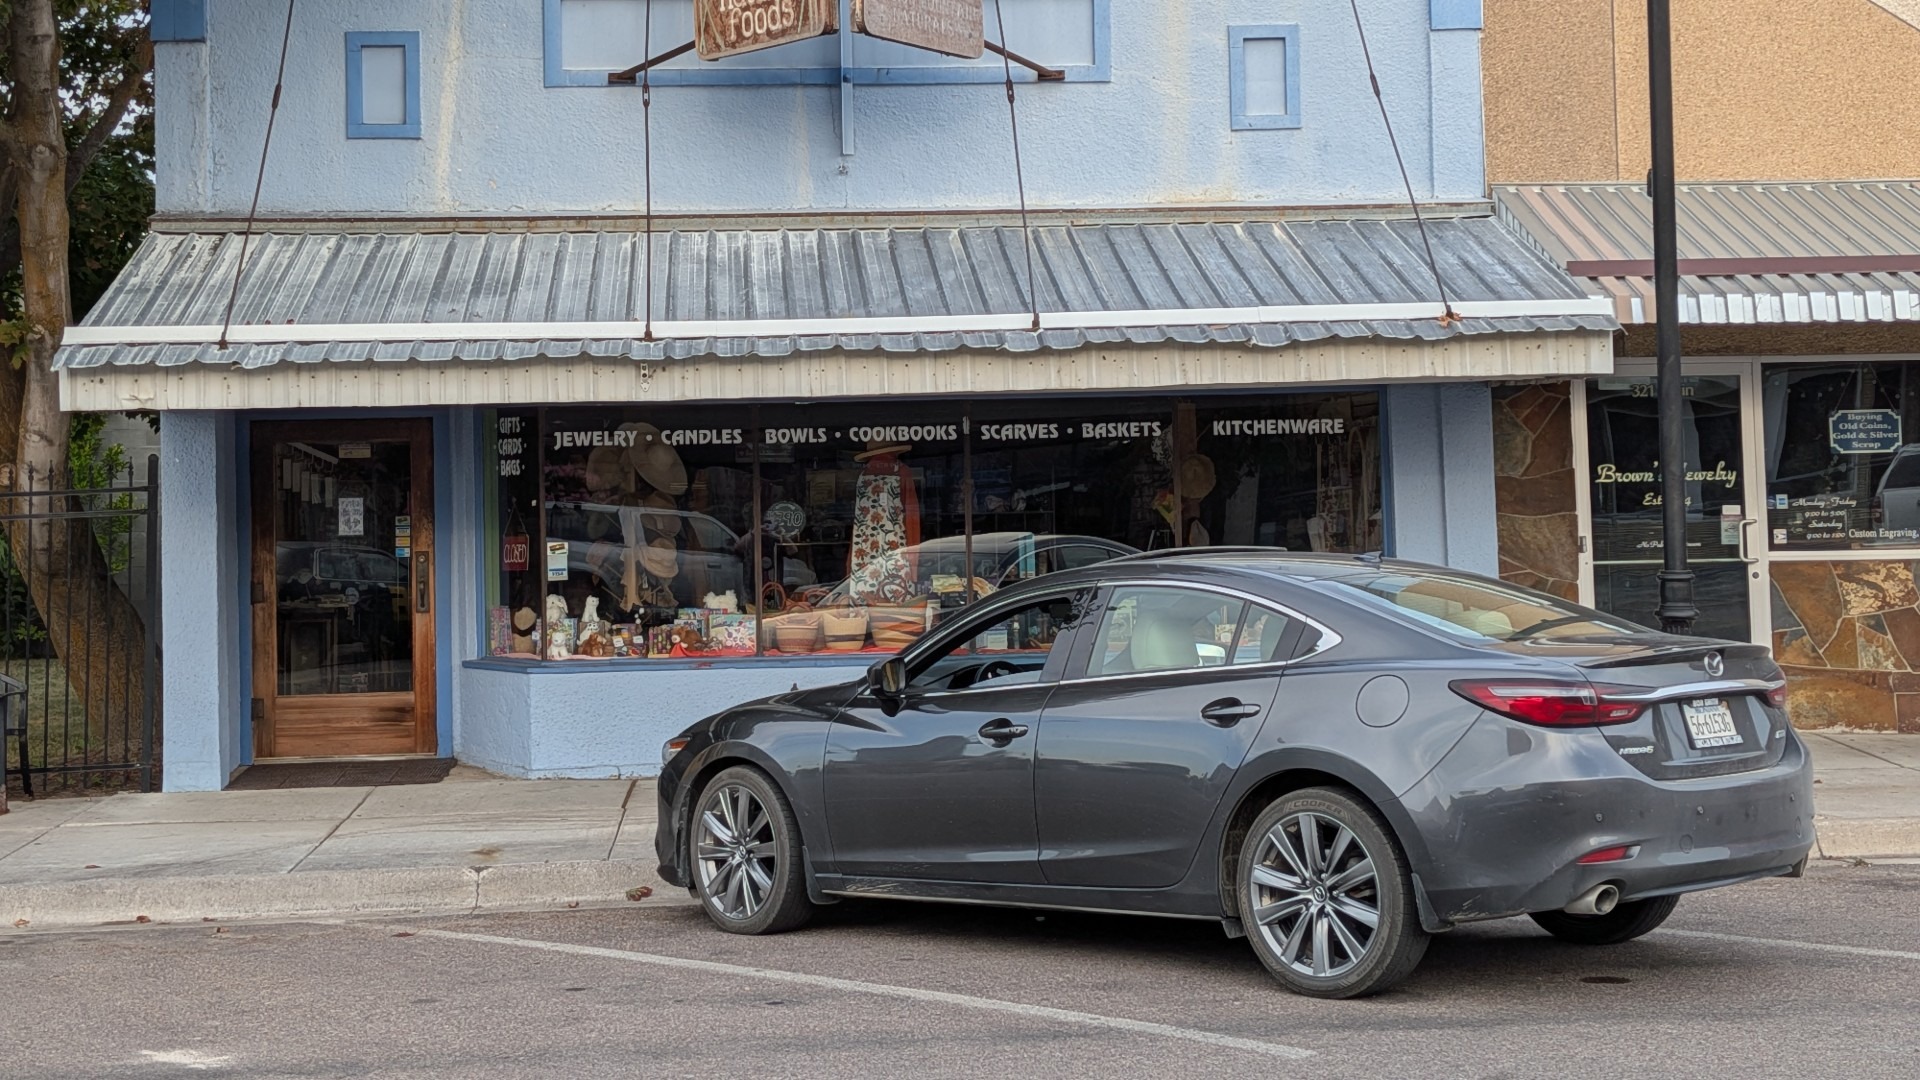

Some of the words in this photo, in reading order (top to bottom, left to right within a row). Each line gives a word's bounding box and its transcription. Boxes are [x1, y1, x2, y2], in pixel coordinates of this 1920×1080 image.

[729, 0, 795, 41] foods
[1632, 384, 1654, 398] 321
[499, 417, 520, 435] GIFTS
[1838, 422, 1858, 430] Old
[1847, 413, 1883, 421] Buying
[553, 430, 638, 450] JEWELRY
[661, 429, 742, 446] CANDLES
[765, 427, 827, 444] BOWLS
[849, 425, 957, 442] COOKBOOKS
[980, 423, 1059, 441] SCARVES
[1082, 421, 1162, 439] BASKETS
[1212, 418, 1345, 436] KITCHENWARE
[1869, 431, 1899, 439] Silver
[498, 437, 523, 456] CARDS
[1851, 441, 1881, 449] Scrap
[500, 459, 521, 477] BAGS
[1682, 460, 1737, 488] ewelry
[1848, 528, 1877, 538] Custom
[503, 544, 527, 563] CLOSED
